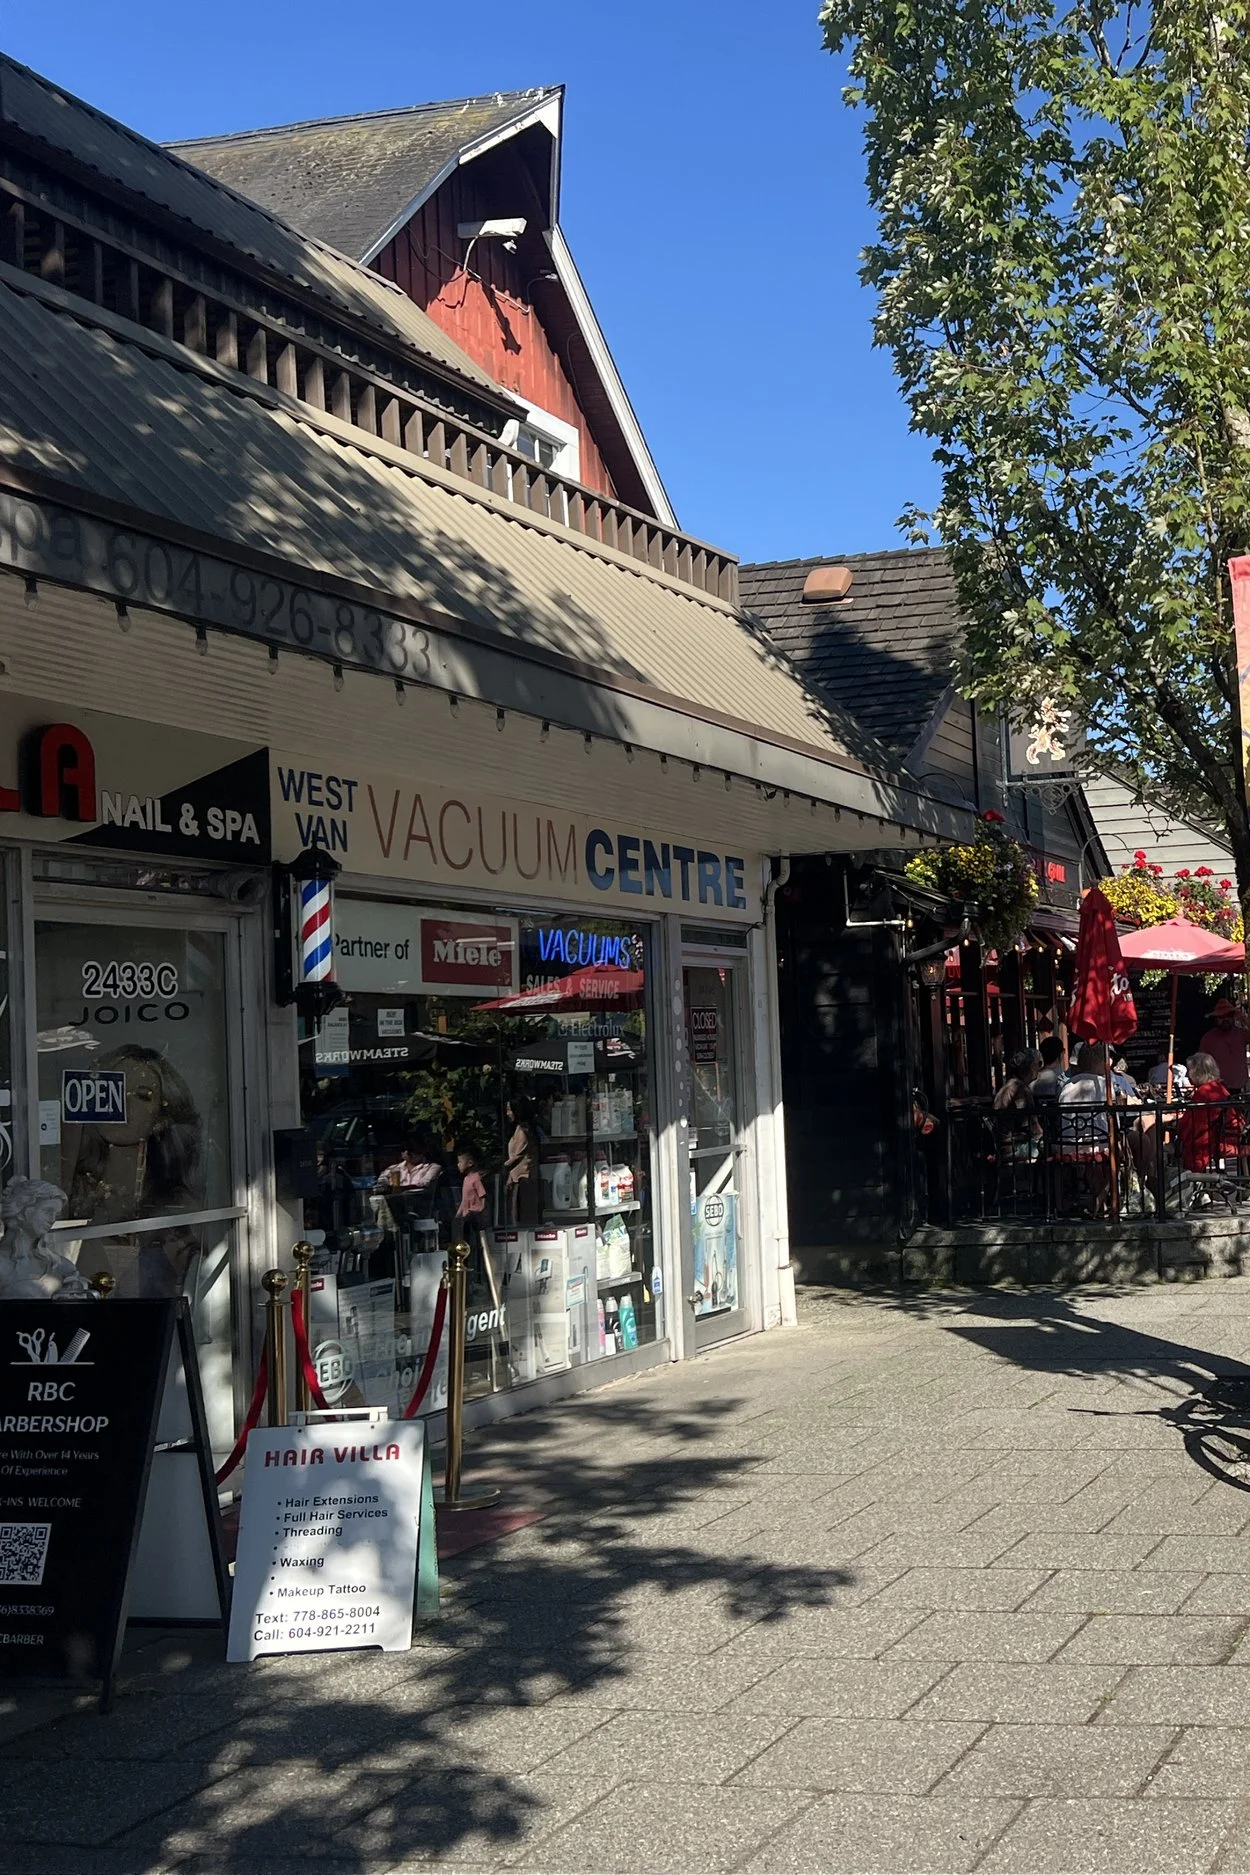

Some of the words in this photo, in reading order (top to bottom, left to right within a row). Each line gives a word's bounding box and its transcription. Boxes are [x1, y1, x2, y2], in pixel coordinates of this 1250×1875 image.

[0, 497, 81, 562] pa
[277, 766, 358, 812] WEST
[102, 790, 172, 833] NAIL
[179, 802, 200, 837] &
[207, 806, 260, 845] SPA
[295, 812, 348, 852] VAN
[367, 784, 578, 886] VACUUM
[585, 828, 747, 910] CENTRE
[394, 938, 410, 960] of
[432, 938, 502, 967] Miele
[538, 928, 632, 969] VACUUMS
[82, 961, 178, 999] 2433C
[526, 974, 561, 995] SALES
[579, 978, 620, 999] SERVICE
[68, 1001, 190, 1026] JOICO
[571, 1019, 625, 1038] Electrolux
[65, 1079, 124, 1113] OPEN
[705, 1203, 724, 1218] SEBO
[27, 1381, 76, 1402] RBC
[0, 1415, 109, 1432] RBERSHOP
[10, 1449, 33, 1460] With
[35, 1449, 58, 1460] Over
[61, 1450, 71, 1460] 14
[73, 1450, 99, 1460] Years
[264, 1447, 325, 1468] HAIR
[333, 1443, 400, 1464] VILLA
[1, 1465, 12, 1476] Of
[15, 1465, 68, 1477] Experience
[28, 1496, 82, 1508] WELCOME
[285, 1497, 309, 1508] Hair
[313, 1493, 379, 1506] Extensions
[284, 1511, 306, 1523] Full
[310, 1510, 335, 1521] Hair
[337, 1508, 388, 1520] Services
[283, 1525, 343, 1537] Threading
[280, 1556, 325, 1568] Waxing
[277, 1586, 325, 1598] Makeup
[328, 1584, 367, 1595] Tattoo
[255, 1612, 289, 1624] Text:
[293, 1605, 380, 1622] 778-865-8004
[254, 1628, 285, 1641] Call:
[288, 1622, 376, 1639] 604-921-2211
